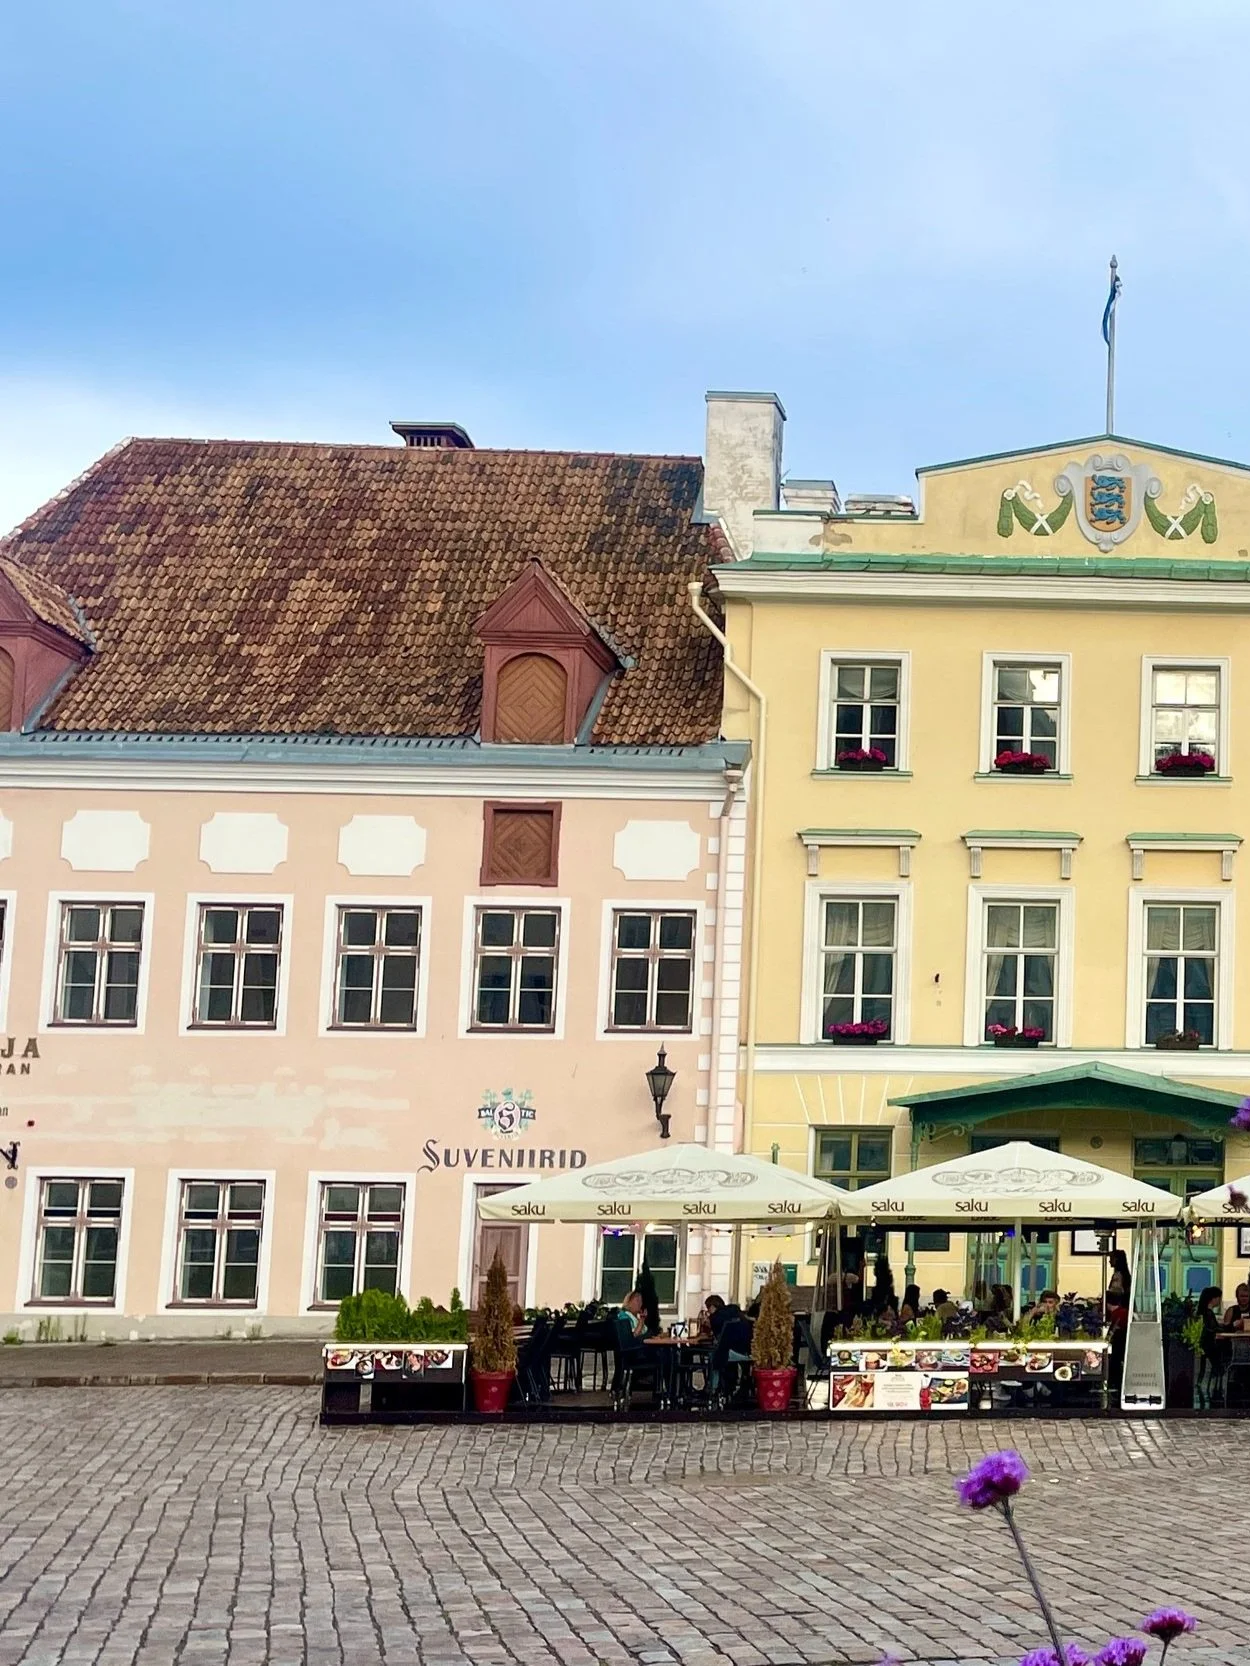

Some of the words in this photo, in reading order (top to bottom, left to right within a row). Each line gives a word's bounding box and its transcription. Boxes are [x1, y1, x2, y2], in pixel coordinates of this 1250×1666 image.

[511, 1202, 546, 1216] saku
[597, 1202, 632, 1216] saku
[682, 1201, 717, 1215] saku
[767, 1200, 802, 1214] saku
[872, 1199, 905, 1213] saku
[955, 1199, 989, 1213] saku
[1039, 1199, 1072, 1213] saku
[1122, 1199, 1155, 1213] saku
